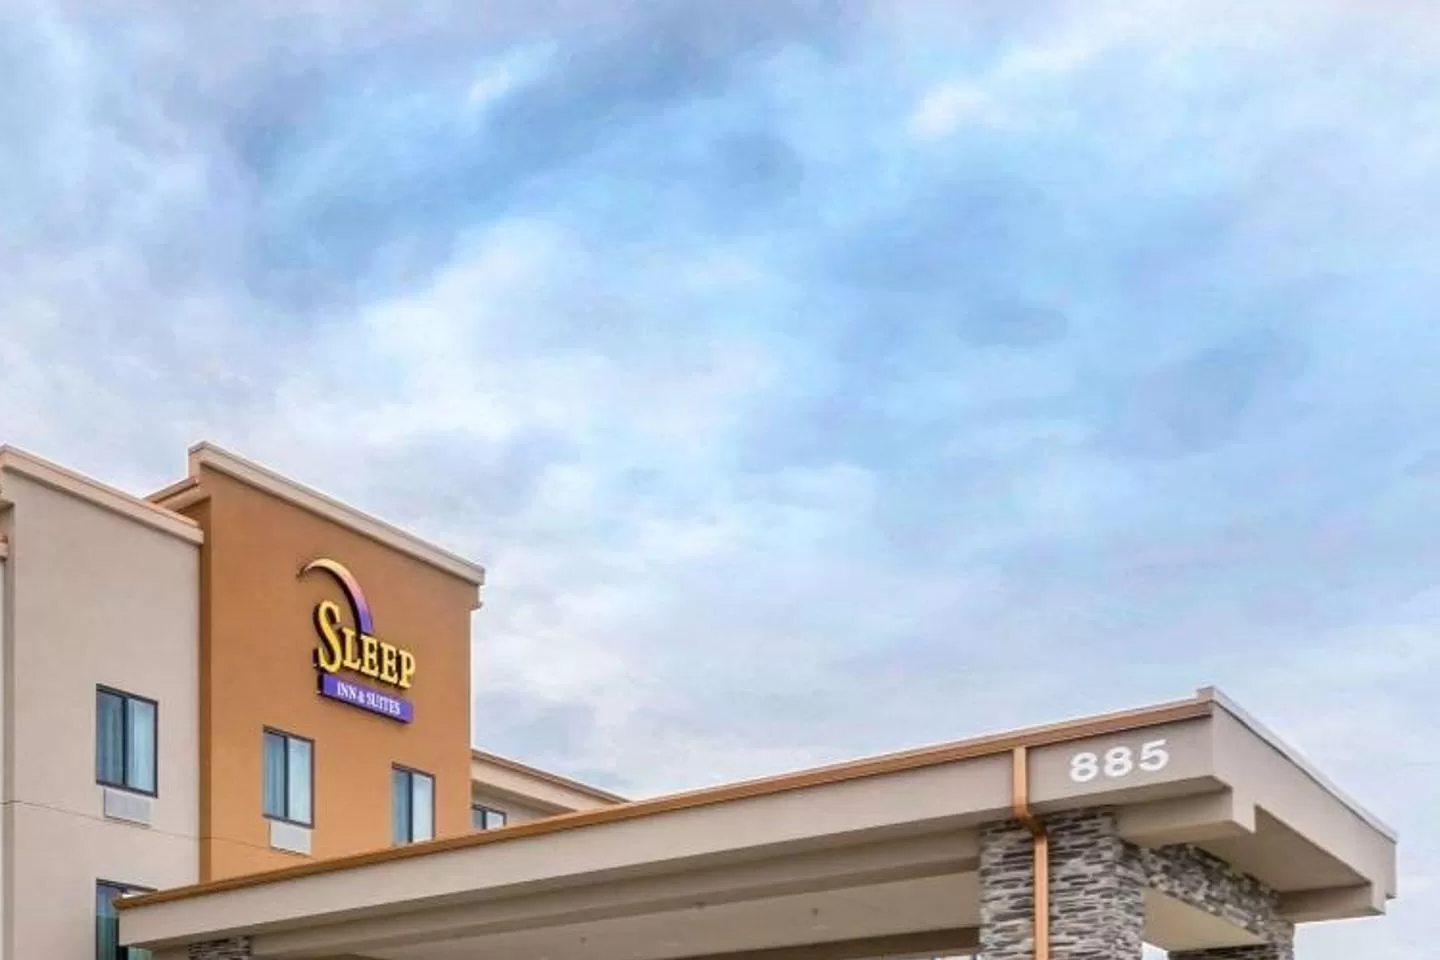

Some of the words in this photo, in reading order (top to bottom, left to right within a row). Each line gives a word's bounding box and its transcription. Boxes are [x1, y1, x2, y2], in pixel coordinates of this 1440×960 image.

[317, 600, 416, 689] SLEEP
[337, 681, 357, 701] INN
[357, 690, 365, 704] &
[366, 691, 401, 715] SUITES
